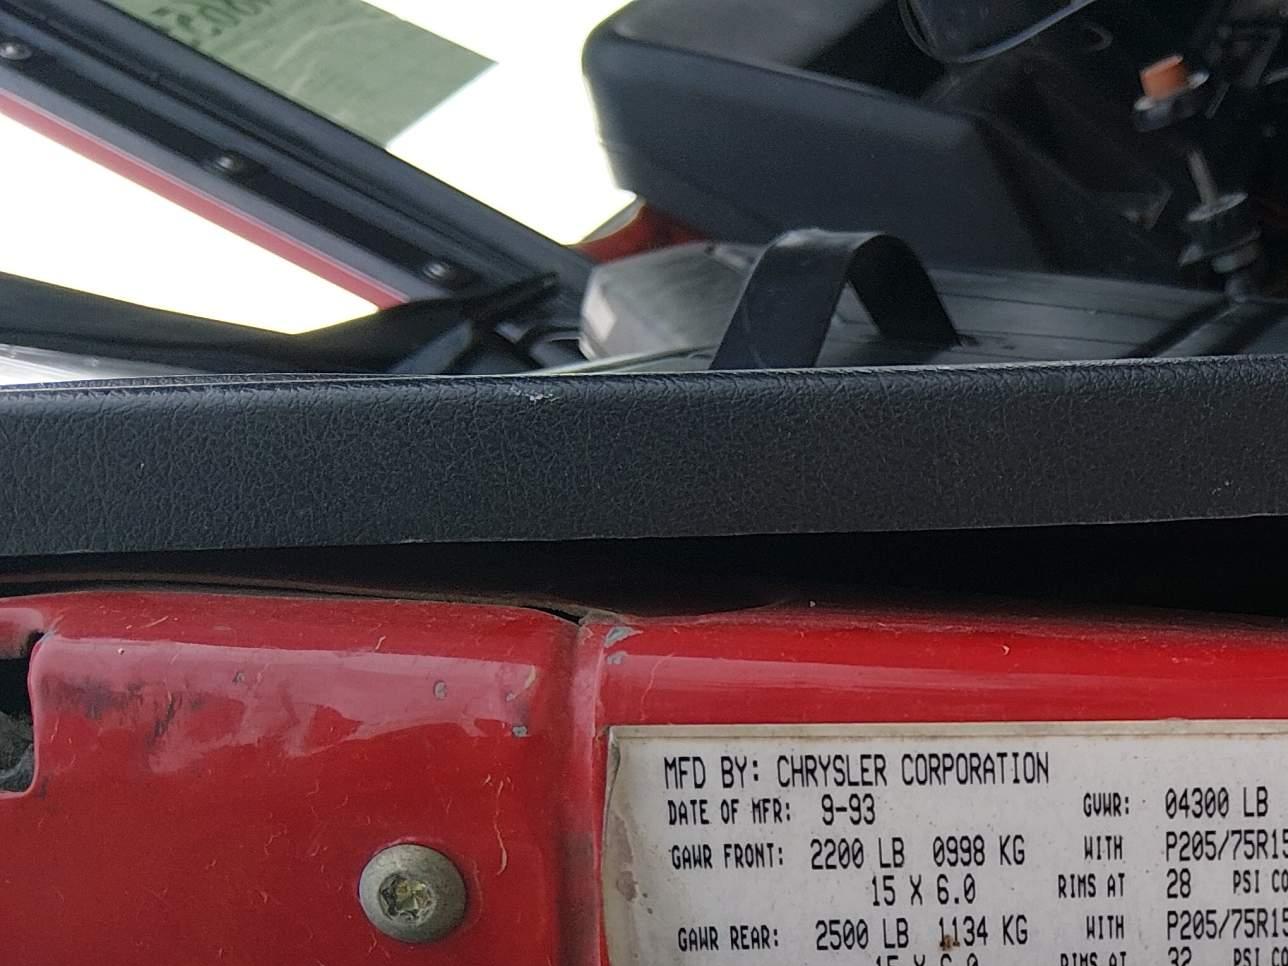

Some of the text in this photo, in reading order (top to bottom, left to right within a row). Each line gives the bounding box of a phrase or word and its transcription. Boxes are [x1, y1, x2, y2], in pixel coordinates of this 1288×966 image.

[664, 751, 1050, 789] MFD BY: CHRYSLER CORPORATION
[668, 793, 876, 826] DATE OF MFR: 9-93
[1083, 792, 1131, 817] GVWR:
[1164, 788, 1230, 819] 04300
[1242, 786, 1268, 817] LB
[671, 834, 1026, 870] GAWR FRONT: 2200 LB 0998 KG
[1084, 836, 1123, 860] WITH
[872, 873, 976, 907] 15 X 6.0
[1058, 874, 1097, 898] RIMS
[1107, 872, 1126, 897] AT
[1166, 868, 1191, 898] 28
[1233, 869, 1261, 894] PSI
[678, 915, 1029, 952] GAWR REAR: 2500 LB 1134 KG
[1086, 915, 1125, 940] WITH
